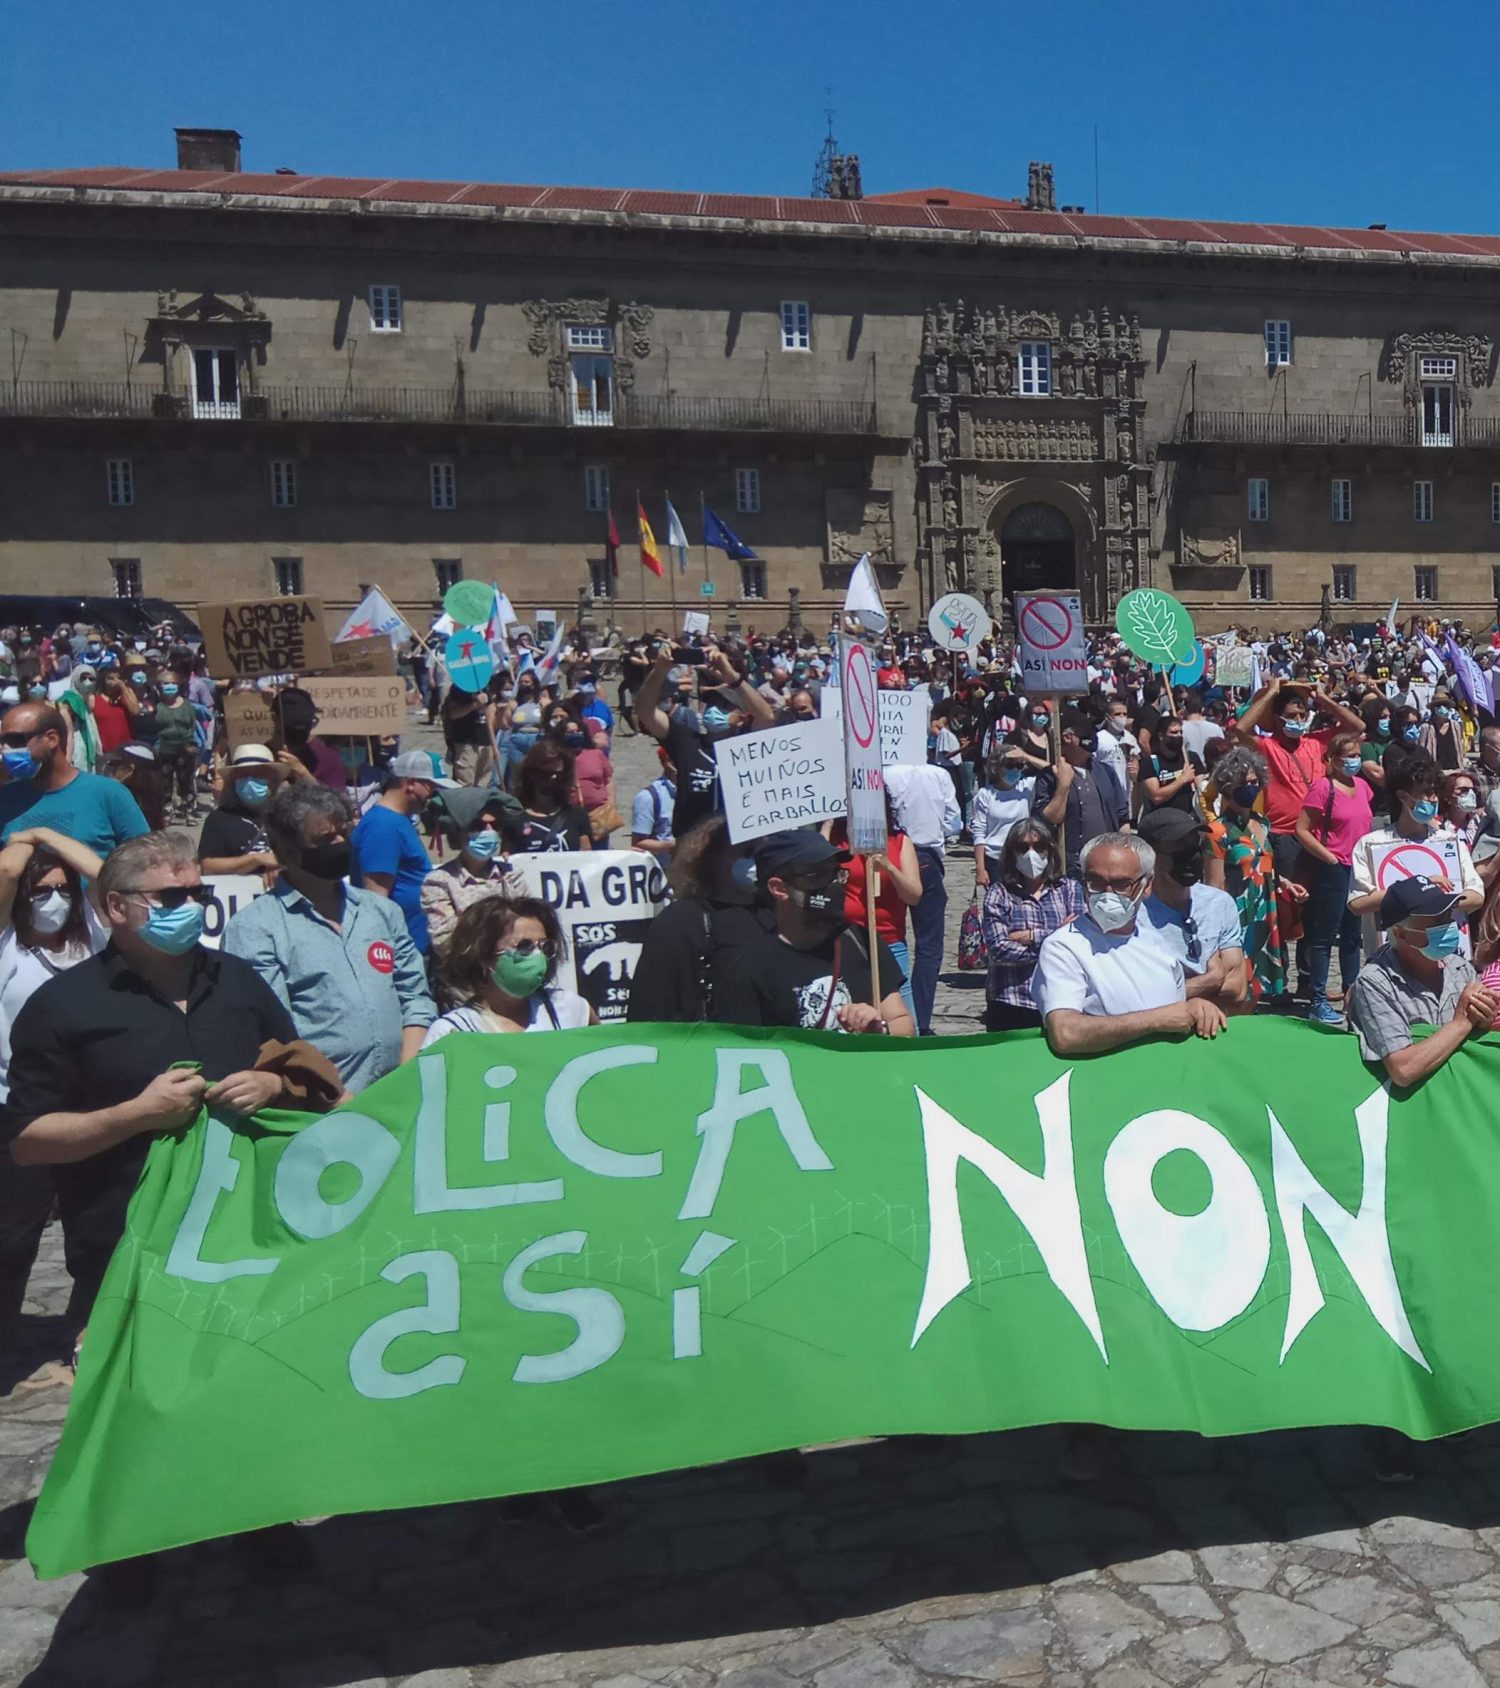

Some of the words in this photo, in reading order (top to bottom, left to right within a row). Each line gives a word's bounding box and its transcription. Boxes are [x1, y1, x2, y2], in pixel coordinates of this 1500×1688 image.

[222, 608, 236, 630] A
[238, 602, 315, 627] GROBA
[224, 627, 271, 652] NON
[272, 624, 304, 647] SE
[227, 647, 305, 674] VENDE
[1051, 659, 1088, 671] NON
[729, 737, 802, 767] MENOS
[738, 758, 825, 788] MUIÑOS
[866, 769, 885, 791] NON
[742, 791, 752, 809] E
[764, 784, 815, 803] MAIS
[540, 869, 591, 910] DA
[602, 864, 670, 906] GRO
[576, 923, 616, 943] SOS
[911, 1067, 1433, 1375] NON
